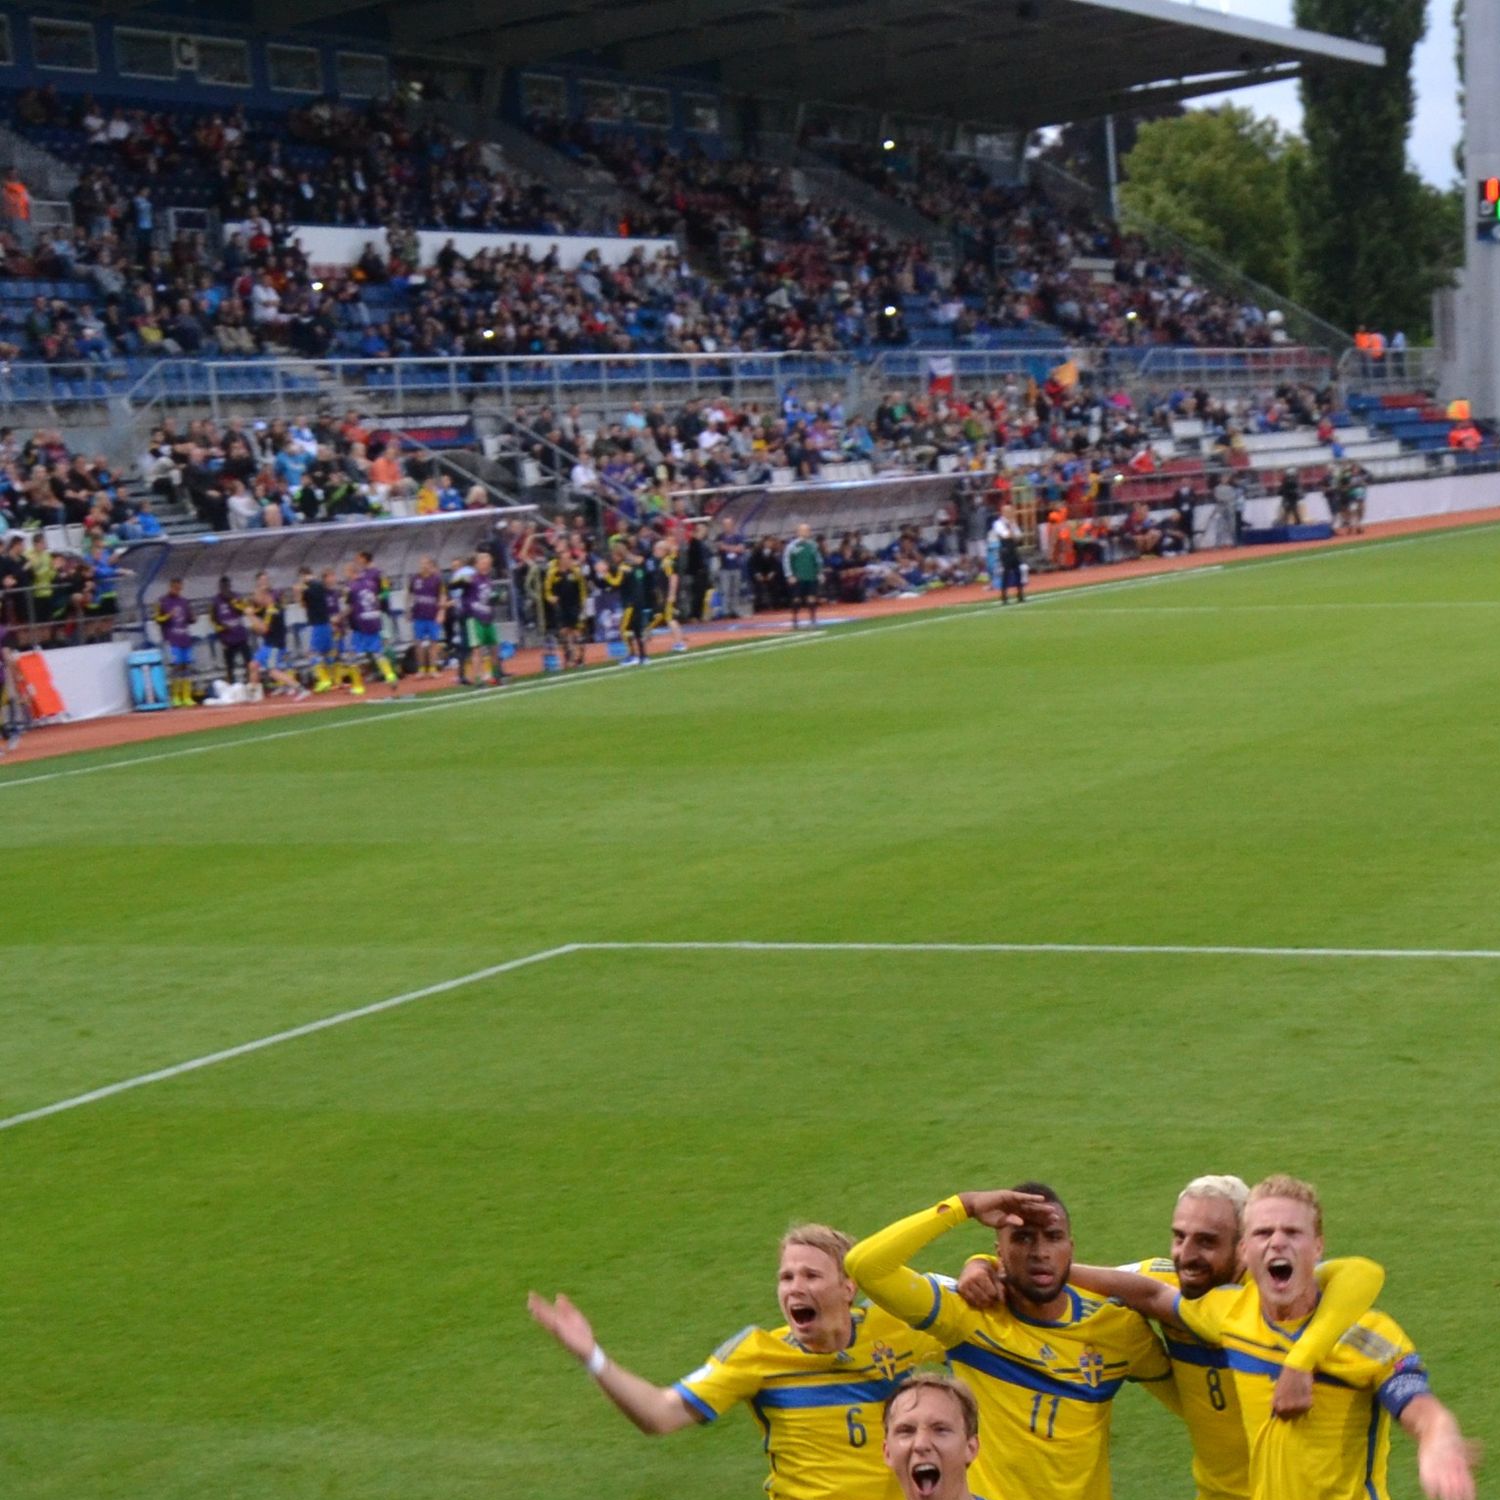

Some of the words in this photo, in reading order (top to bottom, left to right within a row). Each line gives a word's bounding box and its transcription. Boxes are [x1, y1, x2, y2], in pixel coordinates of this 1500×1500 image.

[1485, 177, 1500, 204] 1
[1207, 1369, 1226, 1411] 8
[847, 1407, 867, 1448] 6
[1030, 1393, 1060, 1438] 11
